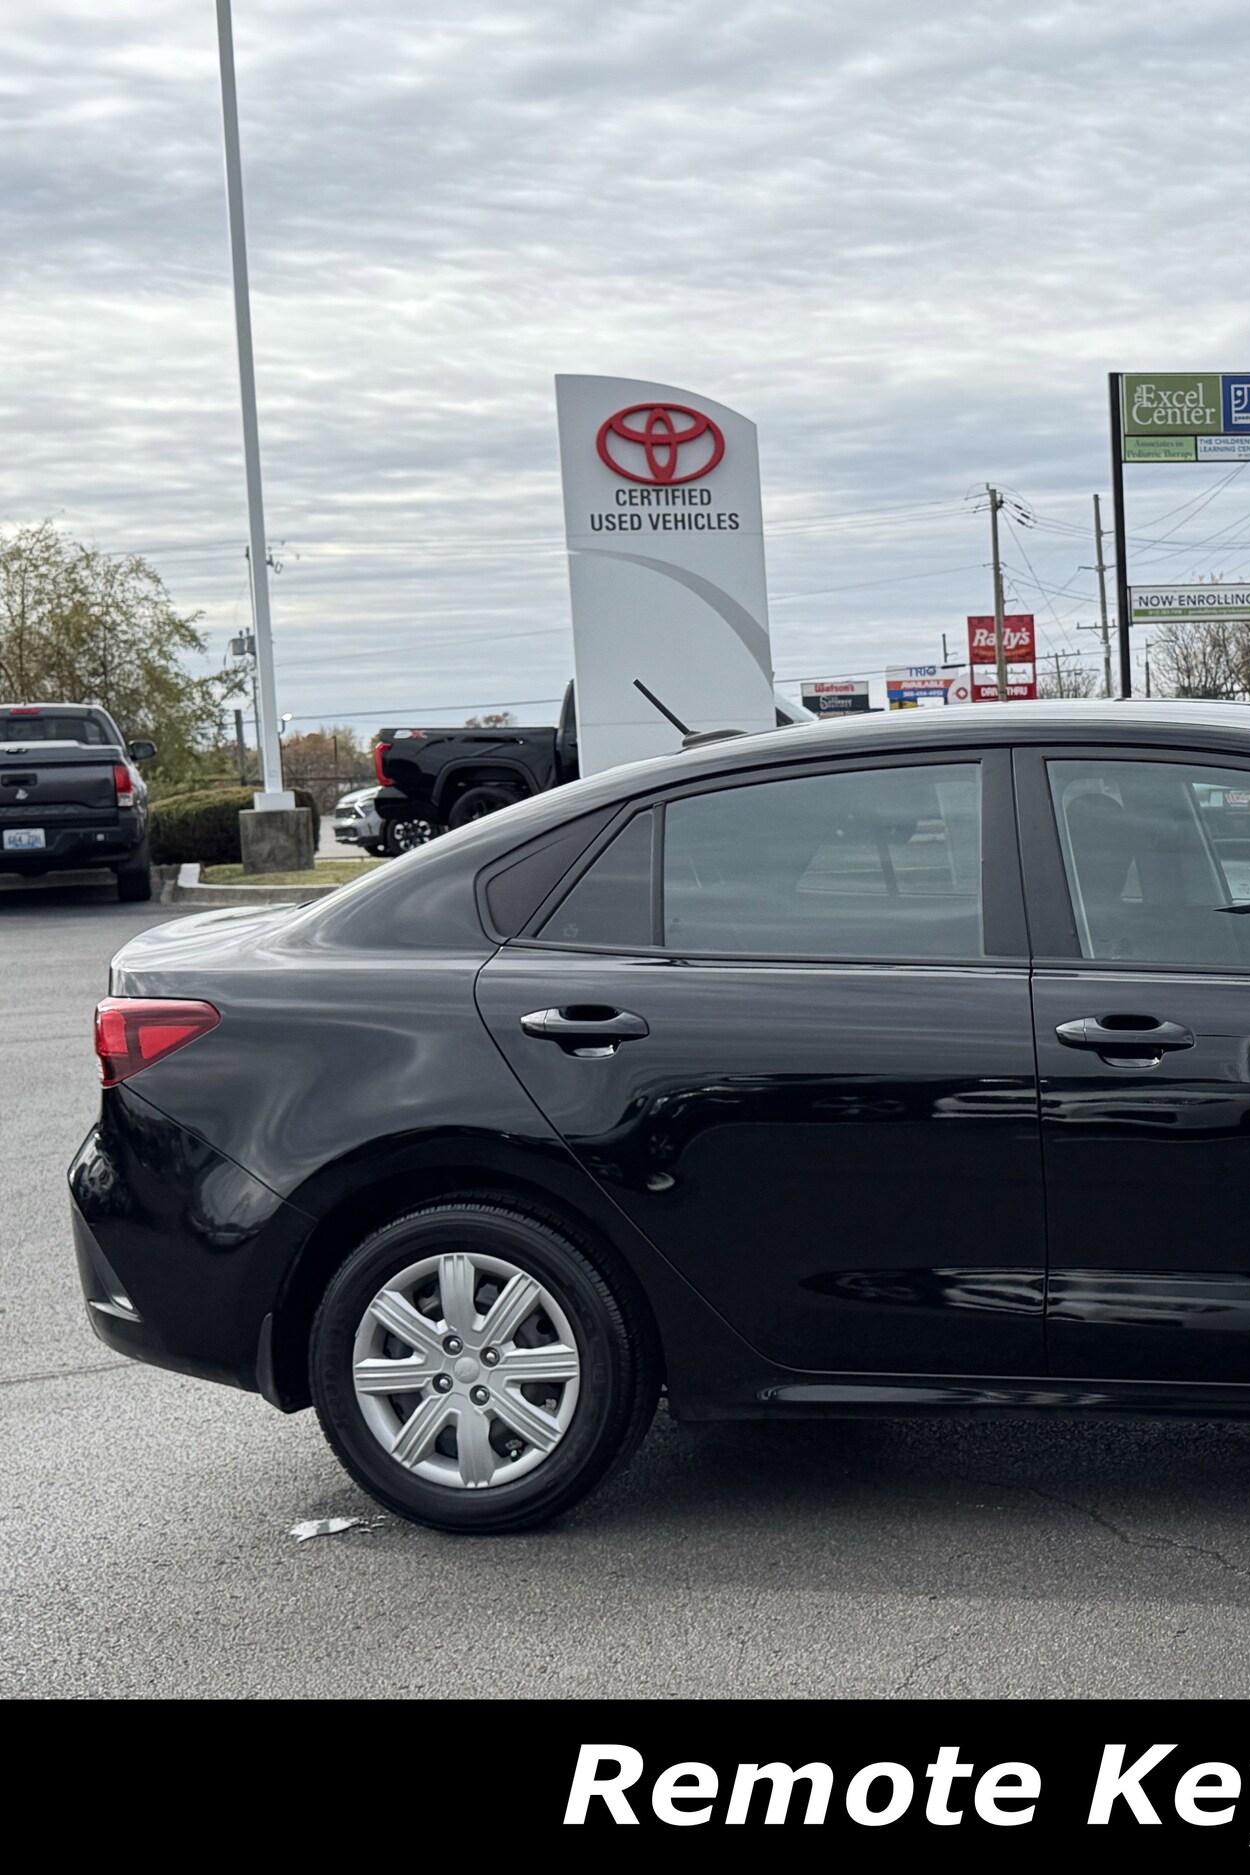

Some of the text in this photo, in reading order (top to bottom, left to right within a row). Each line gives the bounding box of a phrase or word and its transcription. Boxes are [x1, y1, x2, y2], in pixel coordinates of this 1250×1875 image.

[1140, 383, 1205, 408] Excel
[1132, 402, 1216, 425] Center
[1199, 445, 1236, 453] LEARNING
[615, 488, 712, 507] CERTIFIED
[590, 512, 740, 532] USED VEHICLES
[1138, 595, 1174, 607] NOW
[972, 627, 1031, 650] Raly's
